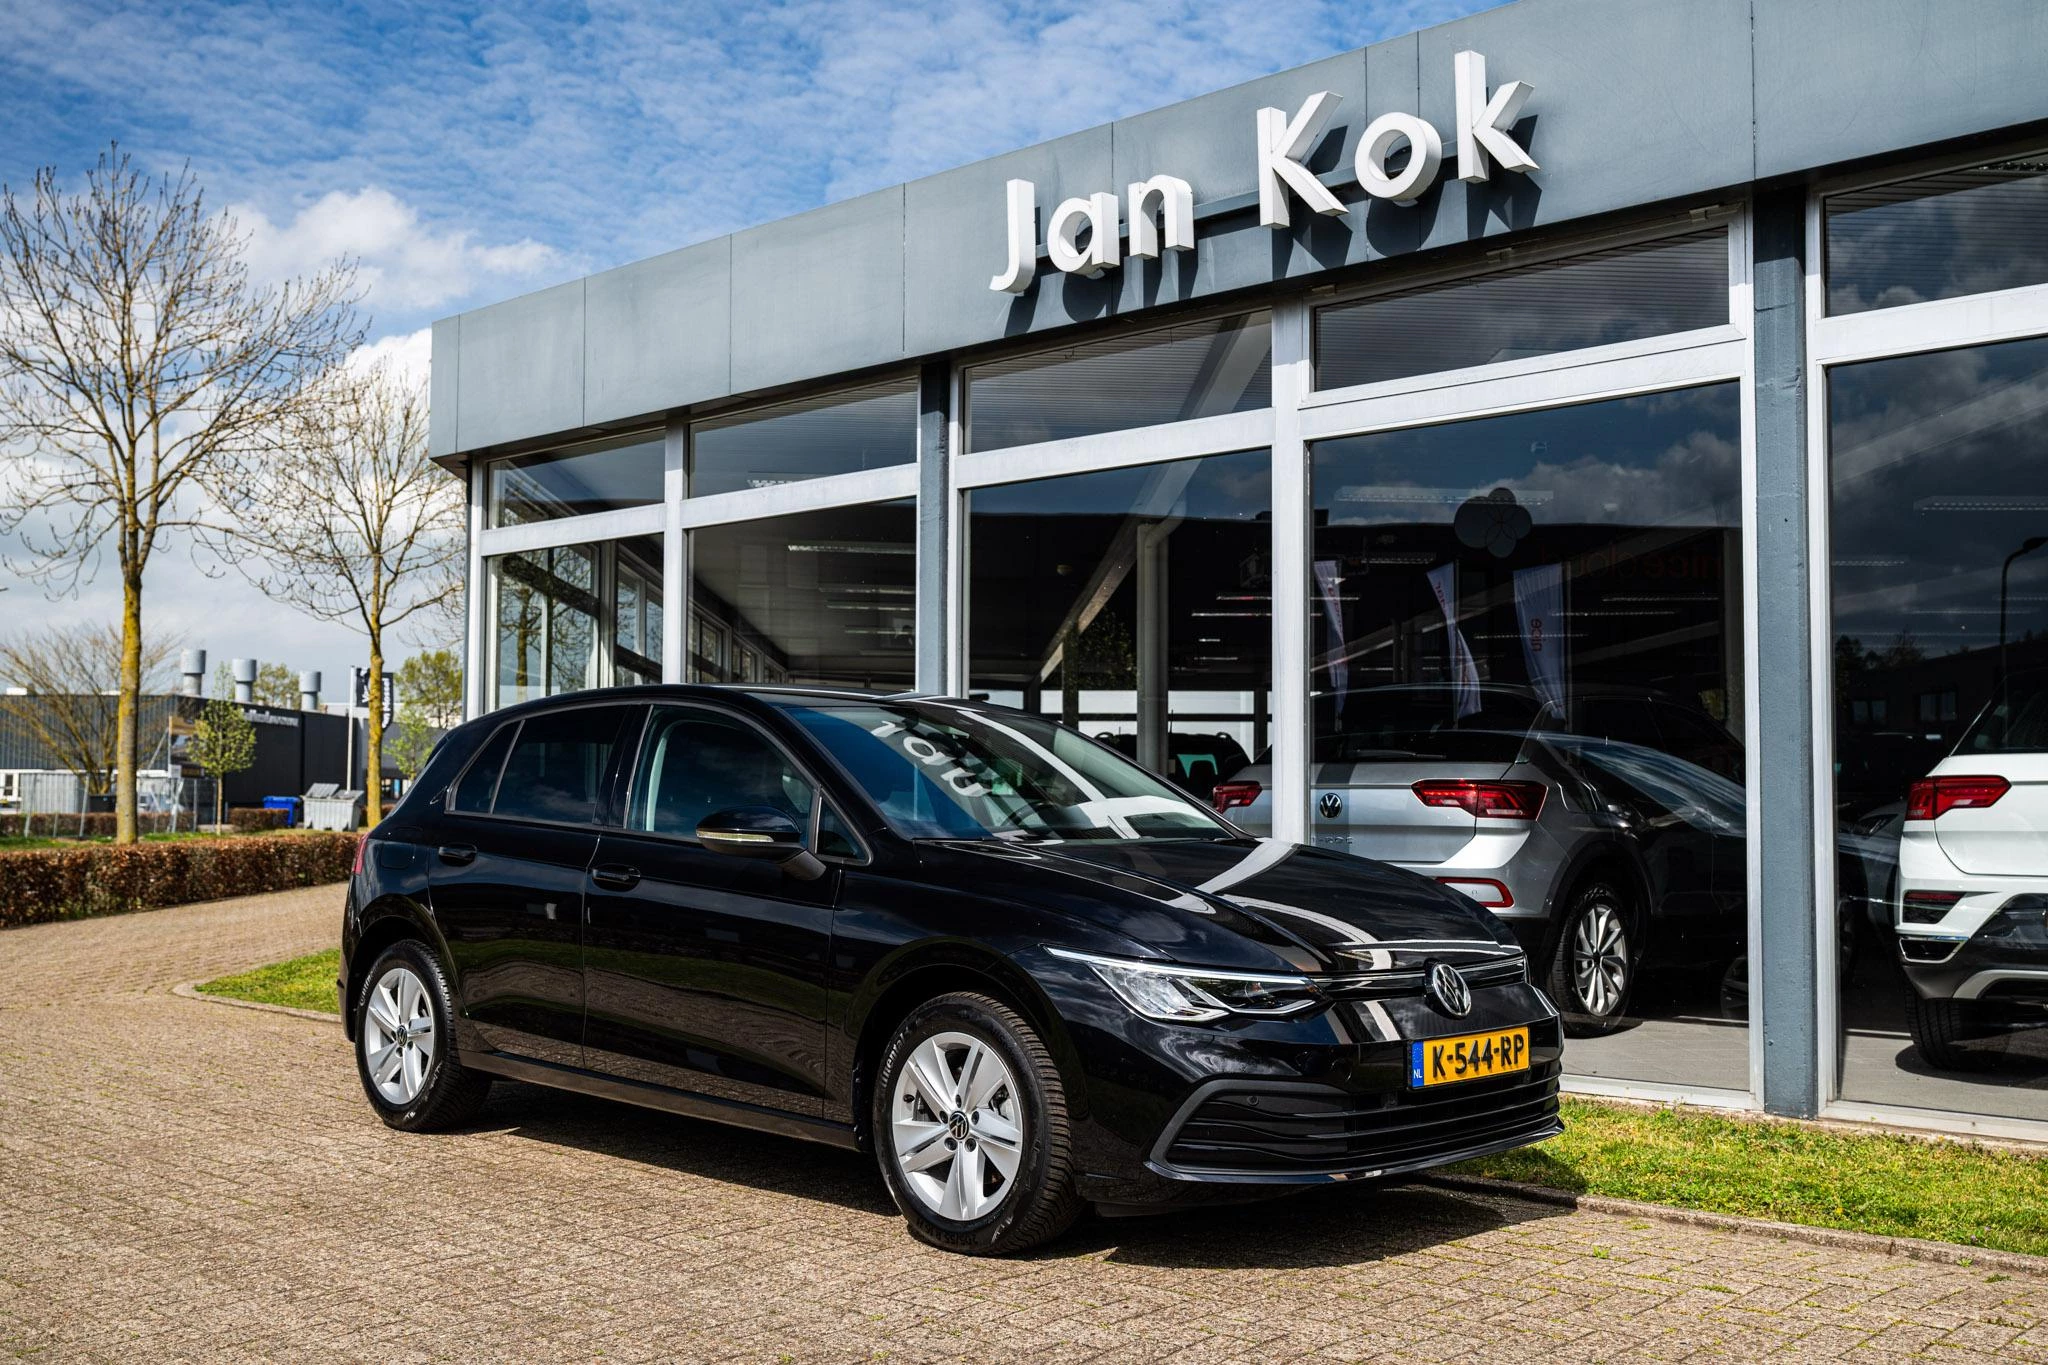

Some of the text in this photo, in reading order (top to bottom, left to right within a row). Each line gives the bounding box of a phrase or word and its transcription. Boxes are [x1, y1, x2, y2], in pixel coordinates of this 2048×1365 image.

[989, 50, 1540, 294] Jan Kok
[1413, 1034, 1525, 1079] NL K-544-RP
